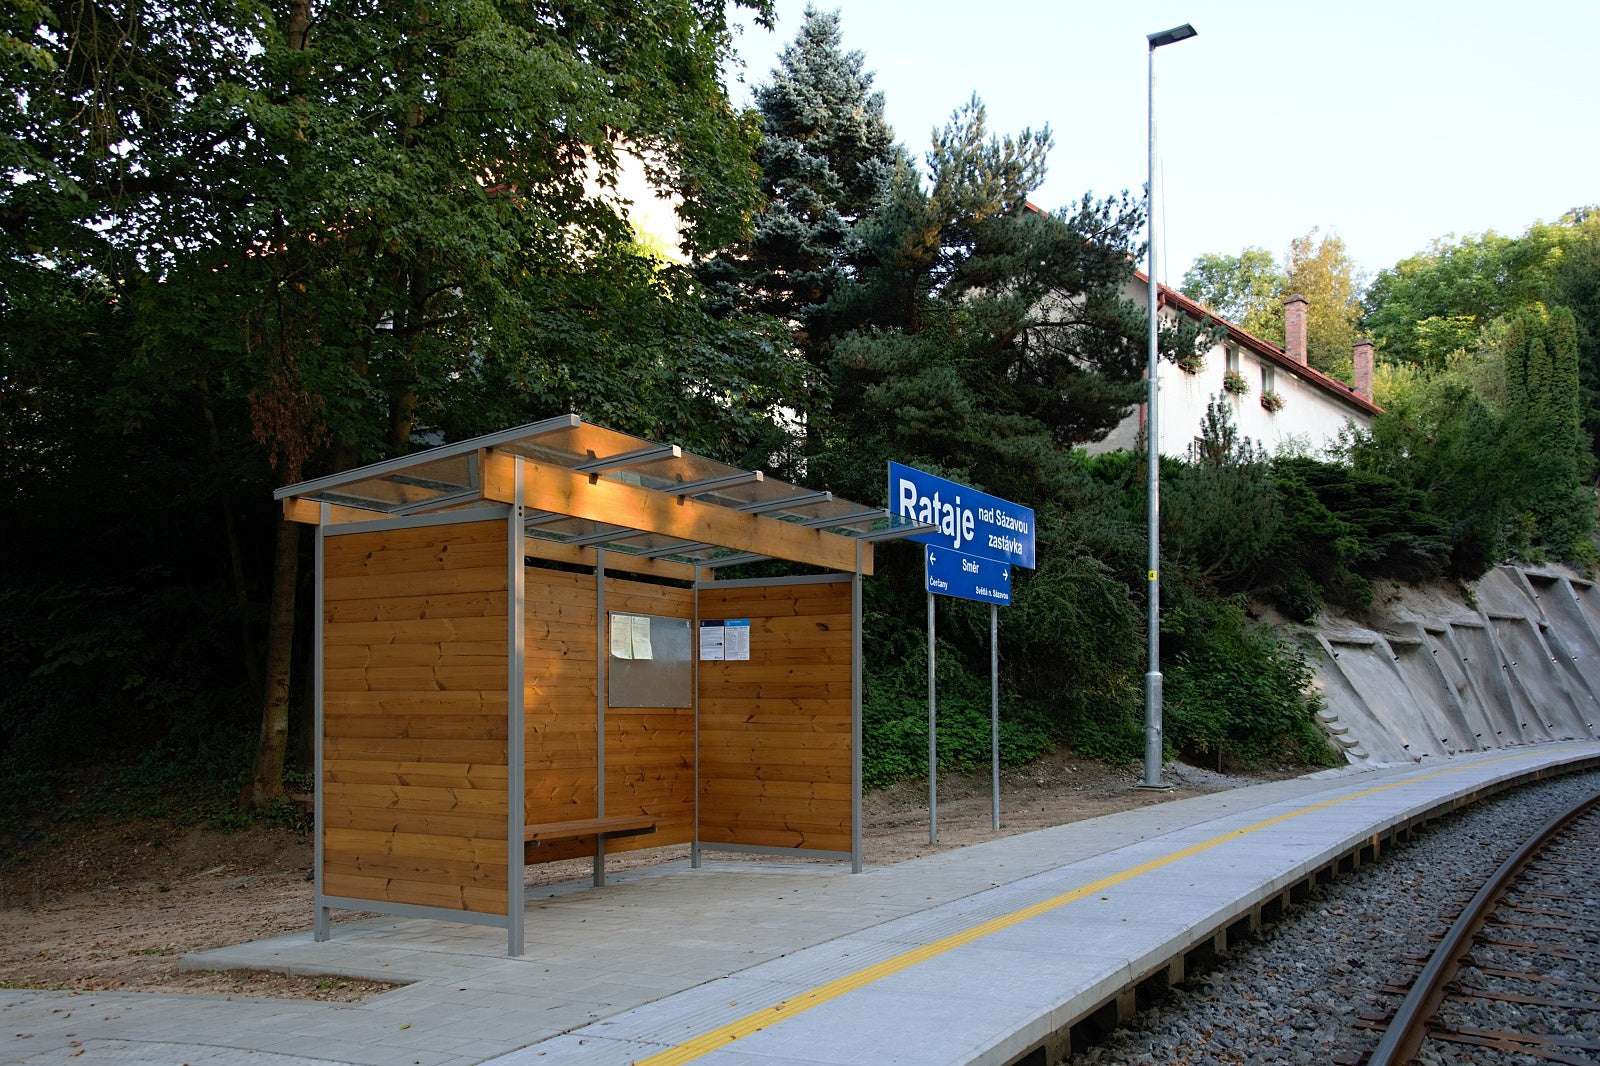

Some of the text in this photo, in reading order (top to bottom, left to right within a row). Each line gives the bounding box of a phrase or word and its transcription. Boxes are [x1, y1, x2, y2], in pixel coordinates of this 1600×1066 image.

[899, 478, 975, 549] Rataje
[978, 507, 1028, 535] nad Sázavou
[988, 533, 1023, 555] zastávka
[962, 558, 980, 574] Směr
